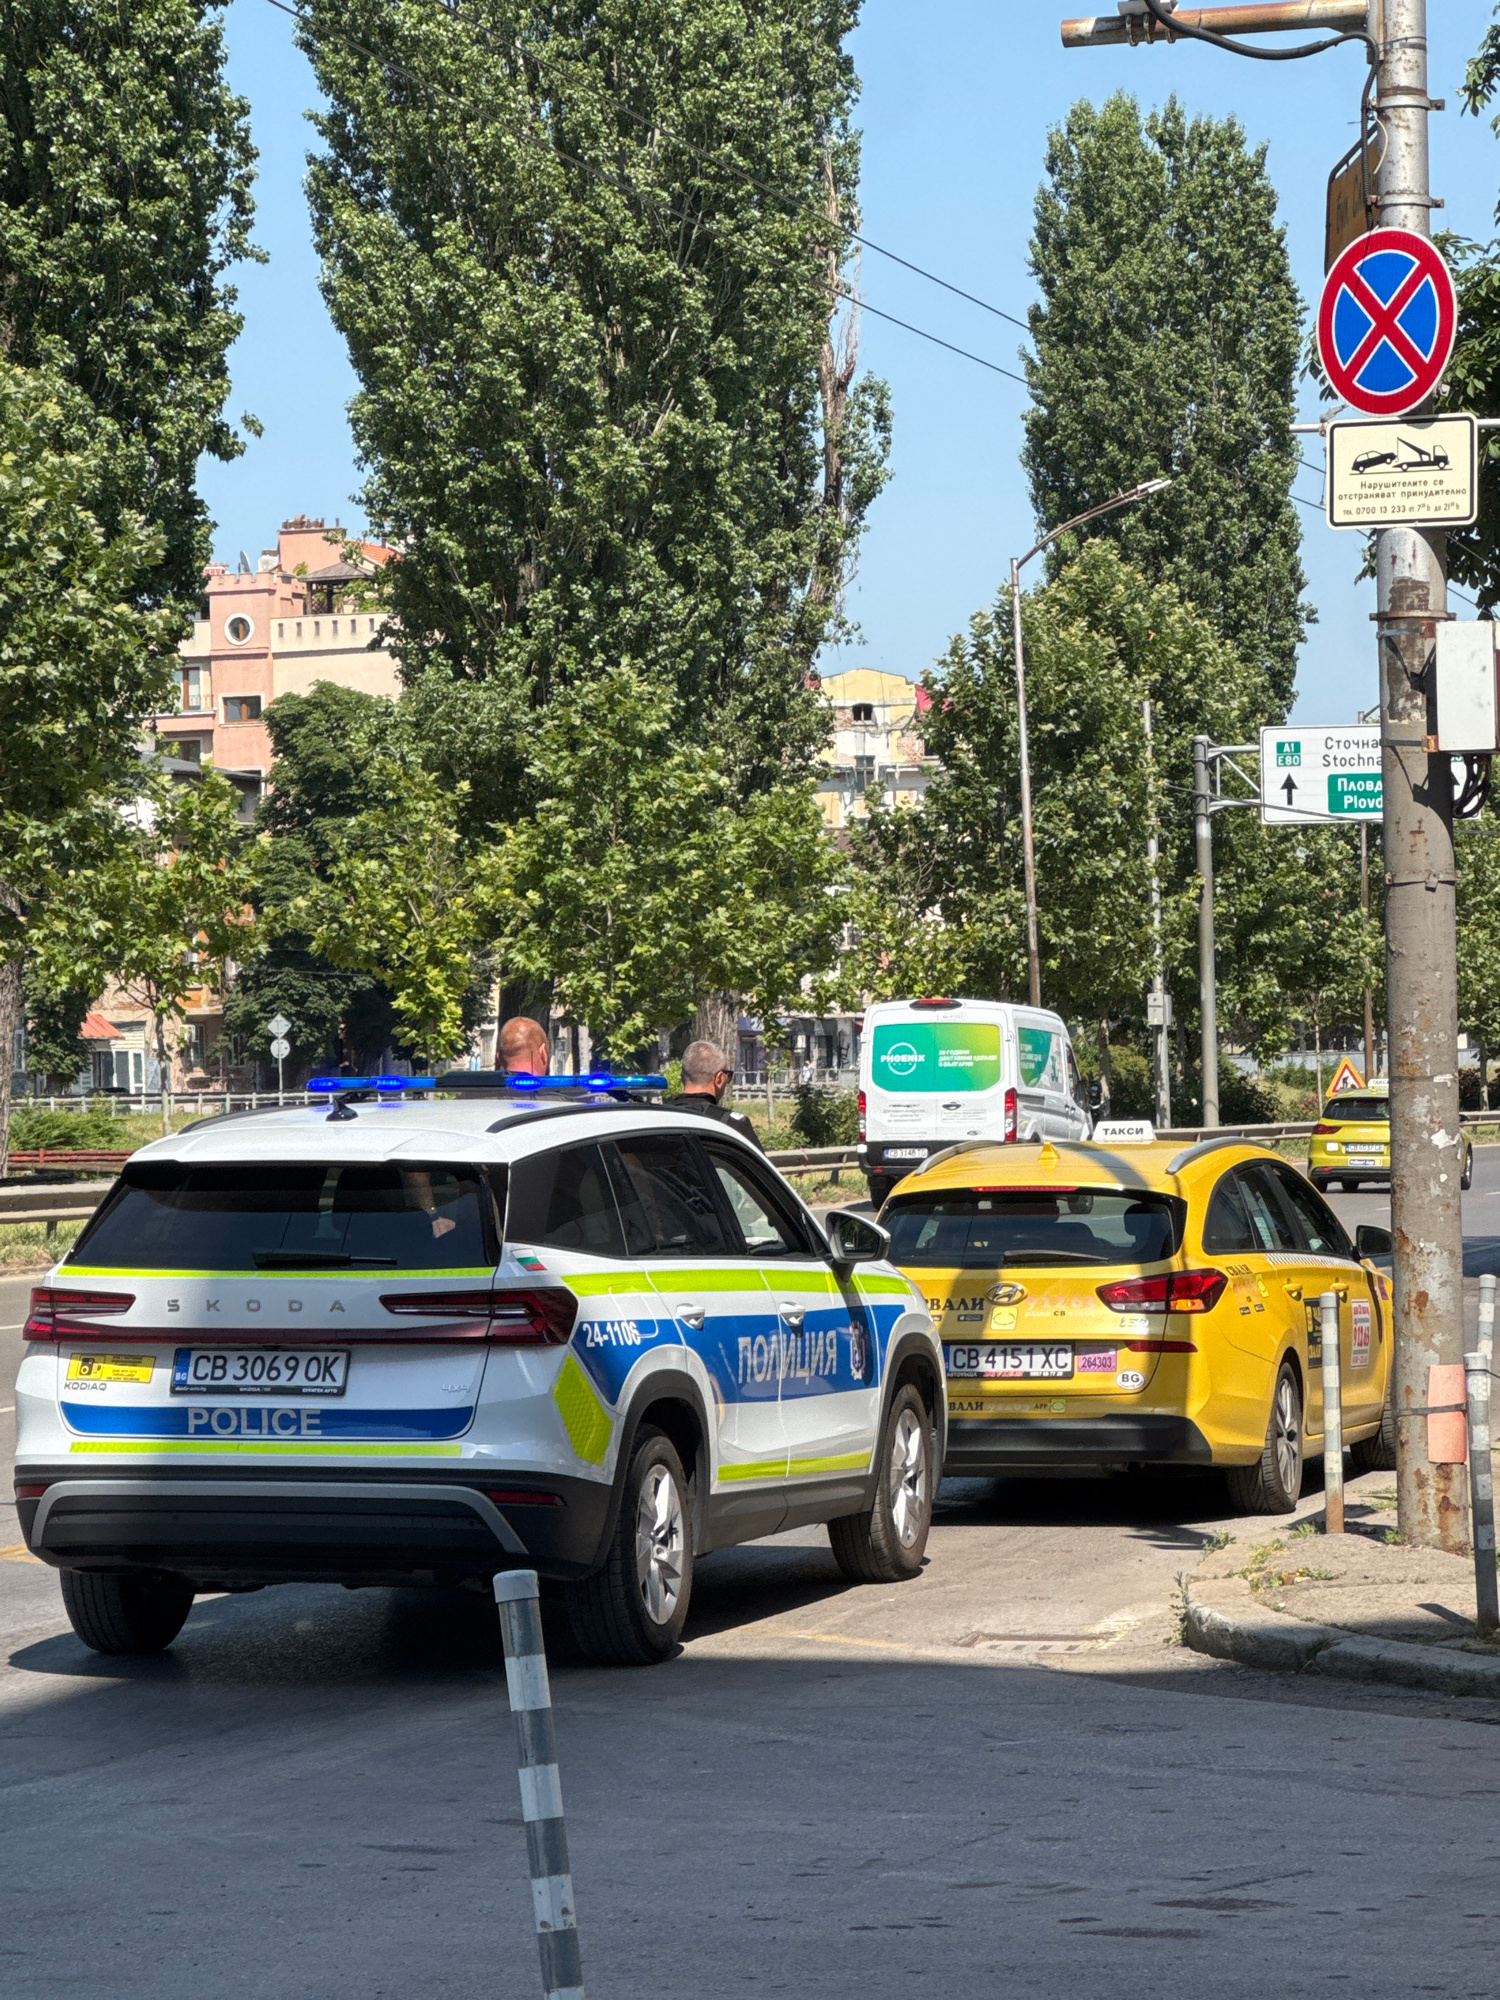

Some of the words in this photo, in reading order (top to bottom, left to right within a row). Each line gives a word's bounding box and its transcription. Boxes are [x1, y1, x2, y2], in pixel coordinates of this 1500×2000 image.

[1360, 479, 1428, 491] Нарушителите
[1433, 478, 1444, 486] се
[1338, 491, 1396, 502] отстраняват
[1401, 488, 1467, 500] принудително
[1356, 506, 1376, 515] 0700
[1380, 505, 1388, 514] 13
[1391, 504, 1406, 513] 233
[1283, 742, 1294, 752] A1
[1278, 755, 1300, 765] E80
[1322, 753, 1383, 767] Stochna
[881, 1054, 925, 1062] PHOENIX
[1102, 1127, 1144, 1136] ТАКСИ
[925, 1297, 985, 1311] ВАЛИ
[582, 1320, 642, 1348] 24-1106
[738, 1330, 837, 1386] ПОЛИЦИЯ
[953, 1347, 980, 1369] CB
[984, 1347, 1034, 1369] 4151
[1040, 1347, 1069, 1369] XC
[1081, 1356, 1112, 1368] 264303
[193, 1356, 227, 1382] CB
[232, 1356, 299, 1382] 3069
[304, 1356, 340, 1383] OK
[174, 1372, 188, 1381] BG
[1121, 1373, 1140, 1383] BG
[64, 1381, 107, 1392] KODIAQ
[187, 1407, 322, 1435] POLICE
